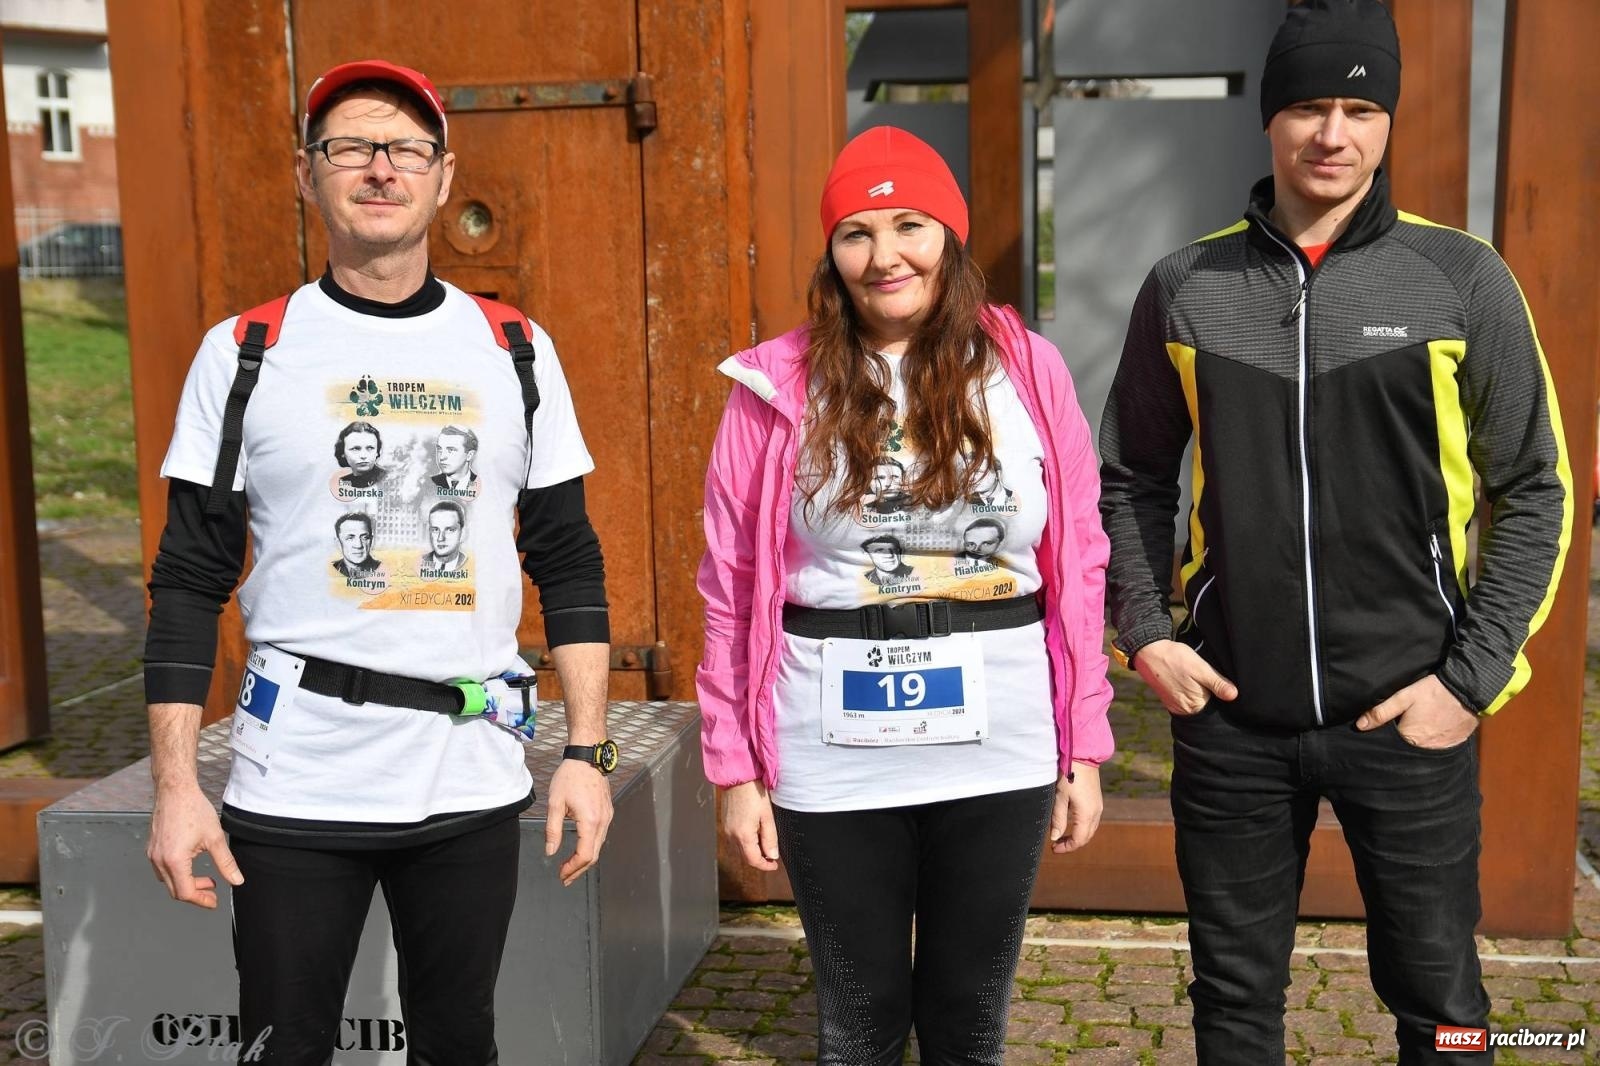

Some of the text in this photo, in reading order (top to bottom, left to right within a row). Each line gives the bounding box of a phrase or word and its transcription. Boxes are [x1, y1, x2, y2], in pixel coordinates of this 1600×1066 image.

[387, 382, 425, 393] TROPEM
[388, 393, 462, 411] WILCZYM
[338, 487, 384, 498] Stolarska
[436, 486, 477, 498] Rodowicz
[971, 503, 1018, 513] Rodowicz
[862, 512, 912, 523] Stolarska
[420, 568, 469, 579] Miatkowski
[346, 577, 386, 591] Kontrym
[878, 583, 921, 595] Kontrym
[992, 581, 1013, 597] 2024
[414, 592, 452, 605] EDYCJA
[887, 645, 910, 654] TROPEM
[887, 651, 932, 666] WILCZYM
[239, 668, 256, 707] 8
[877, 672, 926, 708] 19
